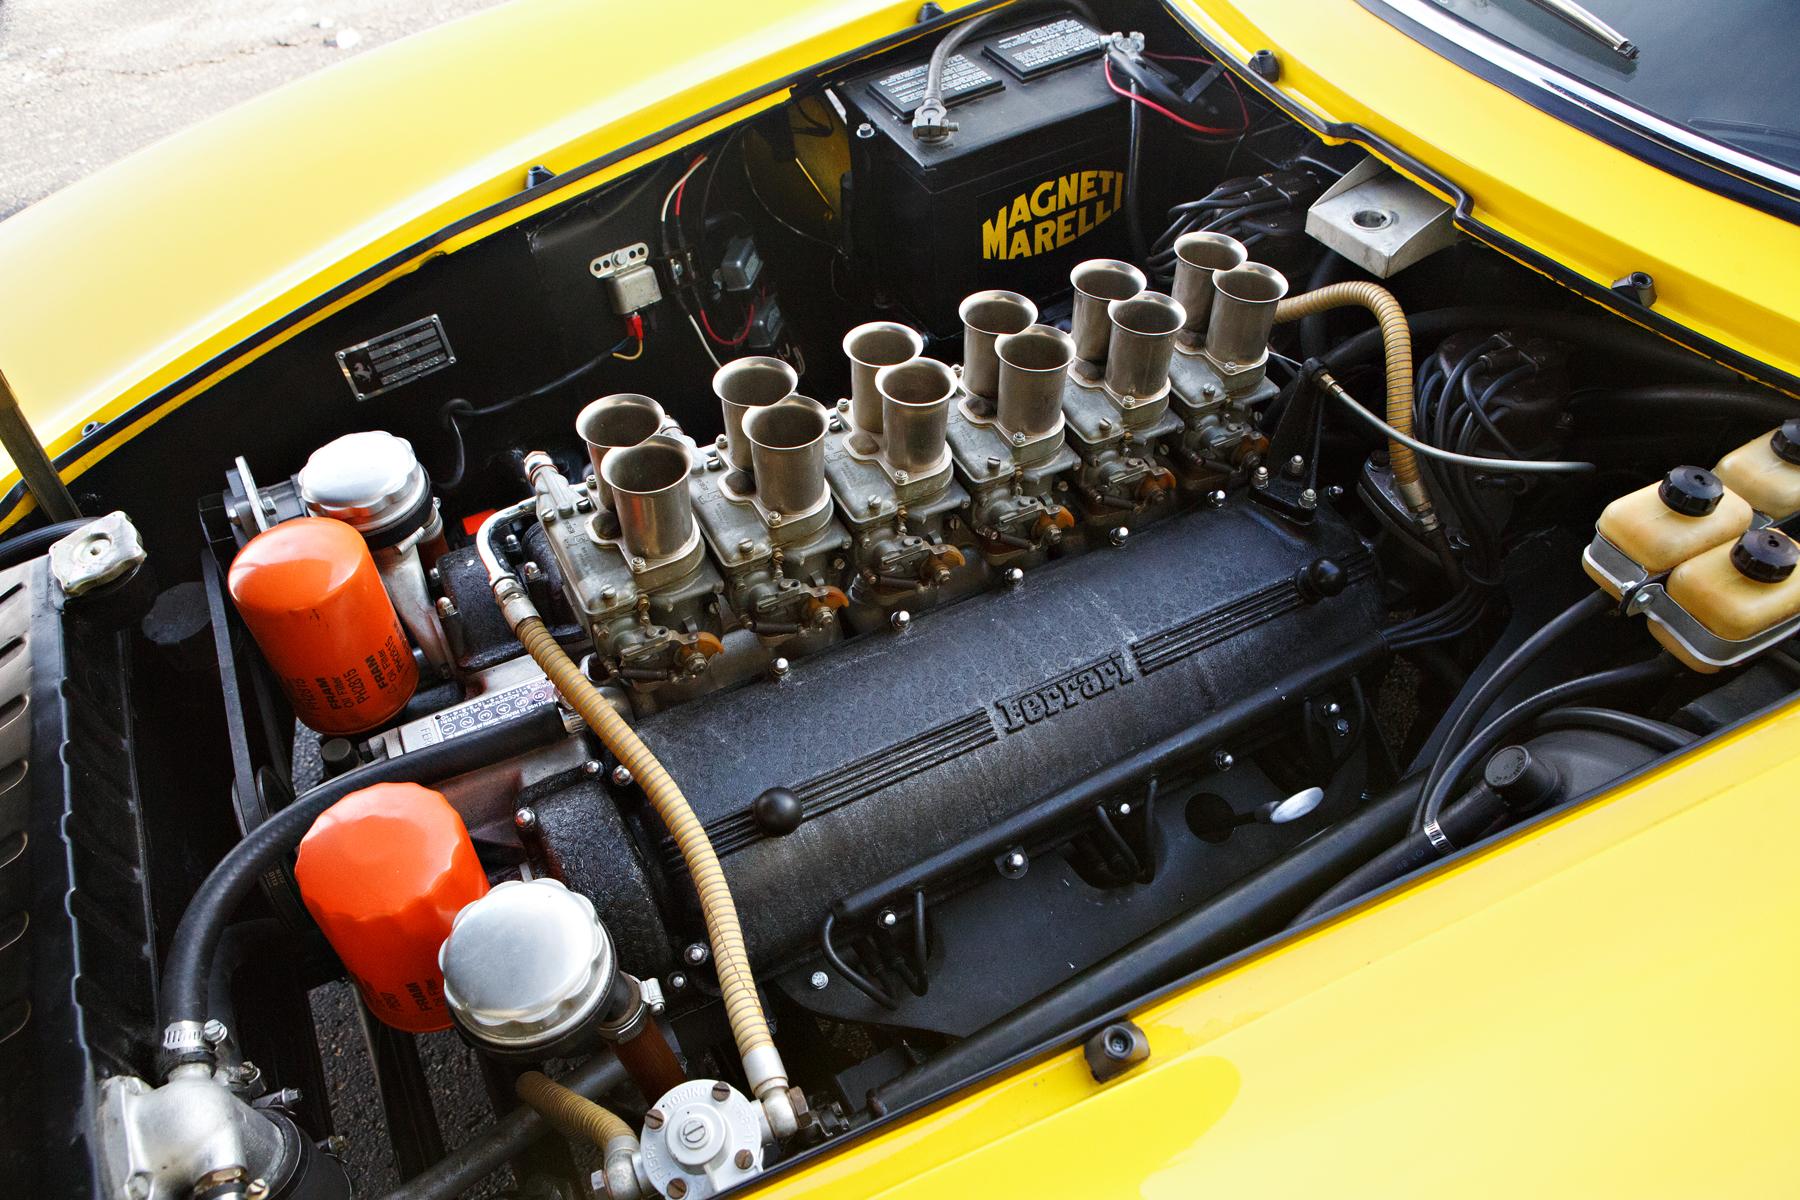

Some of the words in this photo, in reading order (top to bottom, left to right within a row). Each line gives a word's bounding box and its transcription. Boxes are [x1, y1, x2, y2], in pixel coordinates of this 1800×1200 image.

[982, 170, 1124, 252] MAGNETI
[982, 188, 1124, 260] MARELLI
[315, 677, 342, 710] FRAM
[343, 669, 370, 704] PH2815
[365, 655, 388, 689] FRAM
[995, 651, 1134, 735] Ferrari
